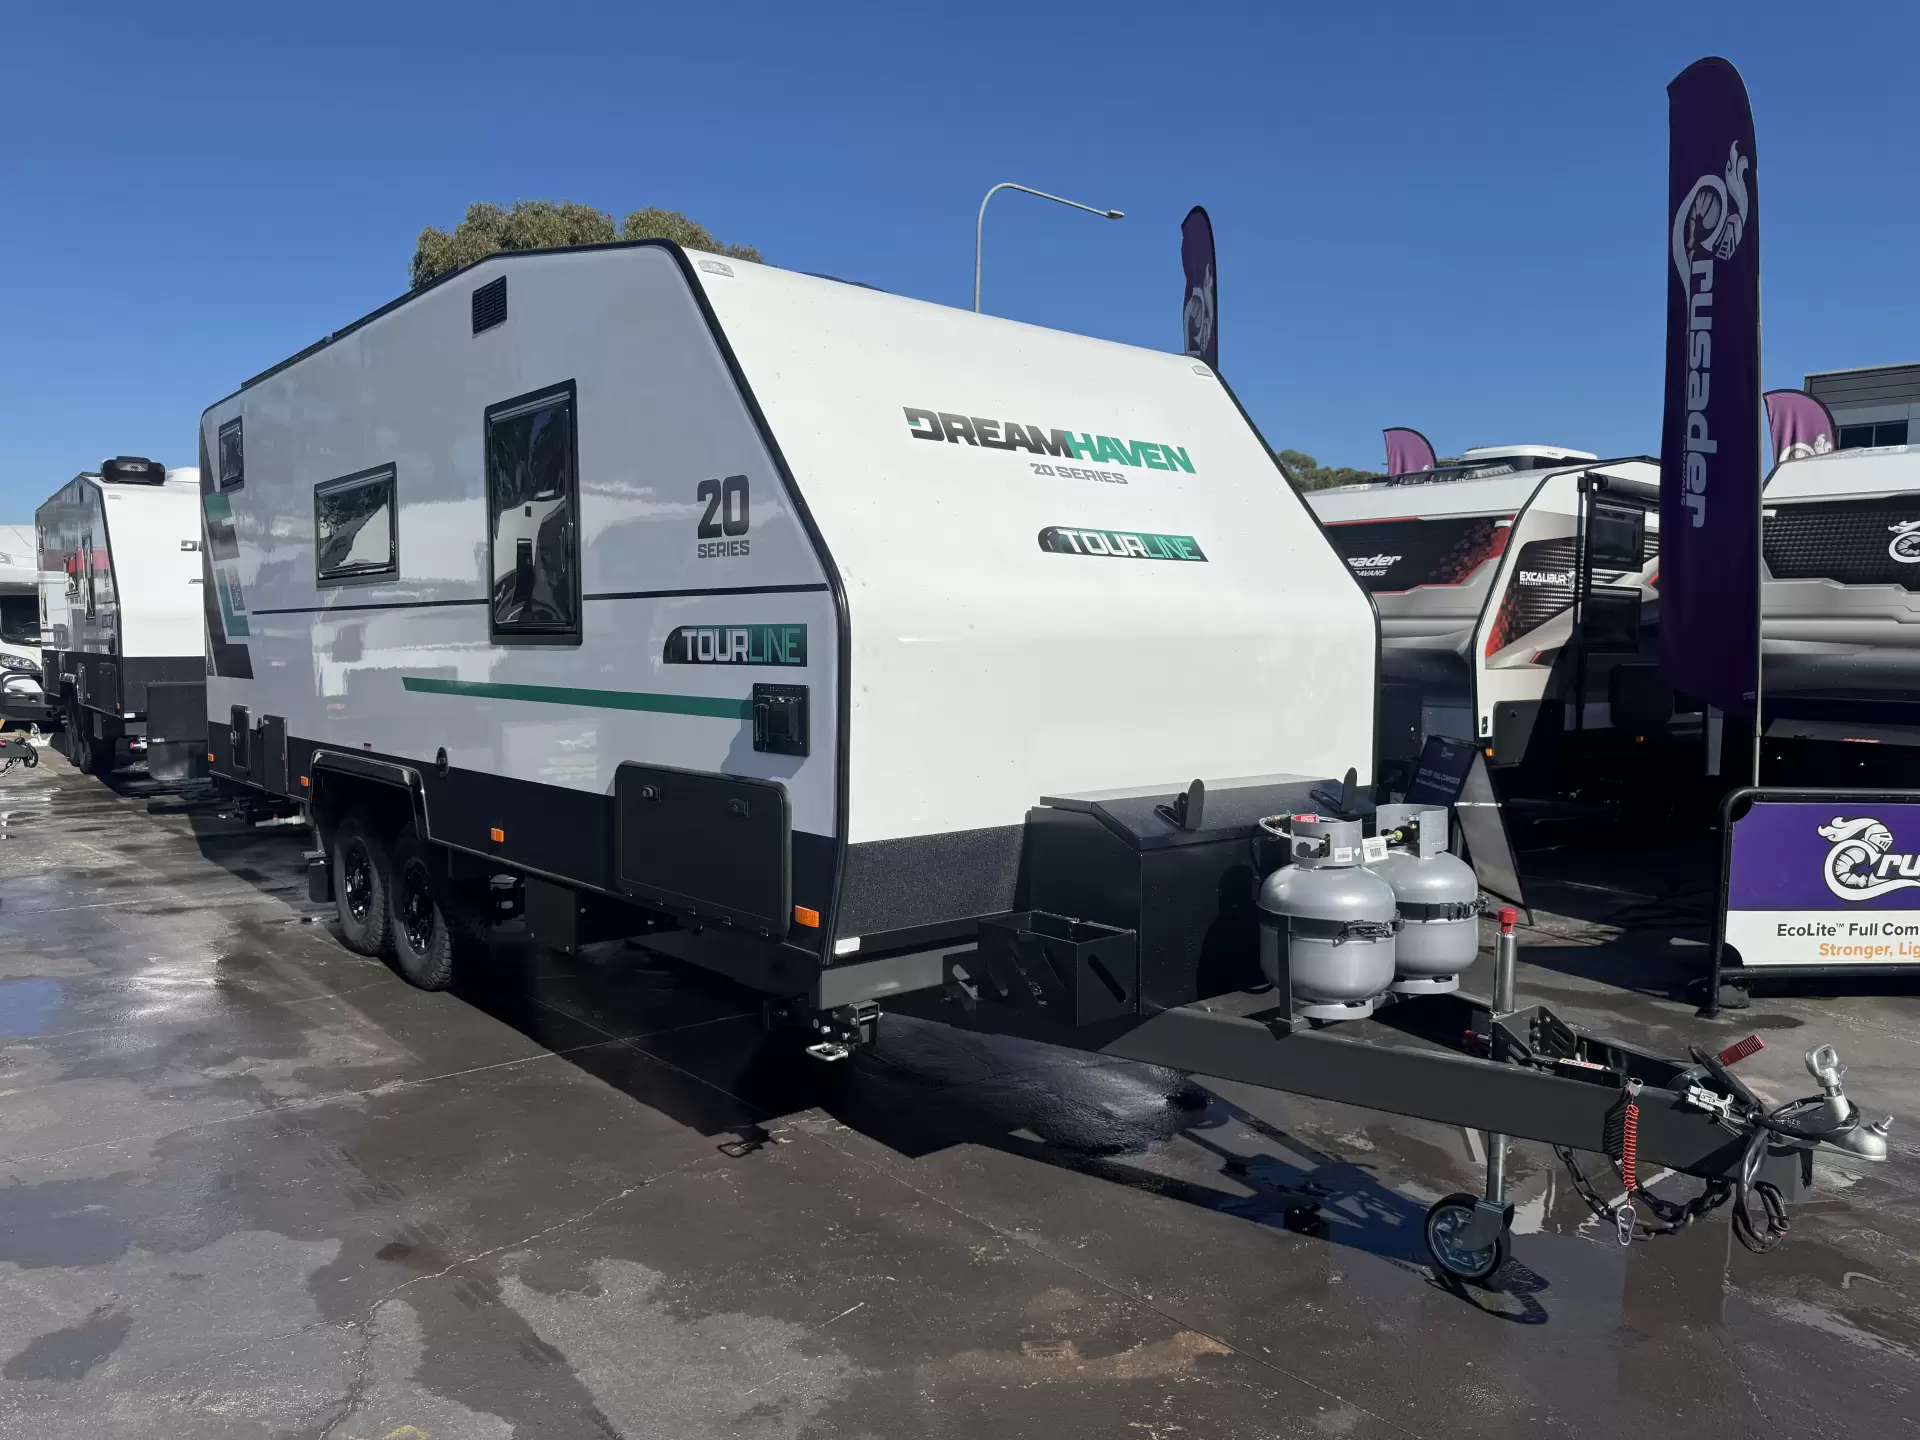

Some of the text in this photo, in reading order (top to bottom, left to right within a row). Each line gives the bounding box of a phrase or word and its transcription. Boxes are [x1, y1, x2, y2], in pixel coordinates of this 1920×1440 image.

[903, 406, 1197, 474] DREAMHAVEN
[1030, 463, 1129, 484] 20 SERIES
[697, 475, 750, 539] 20
[697, 540, 750, 559] SERIES
[1056, 528, 1202, 560] TOURLINE
[1519, 571, 1567, 586] EXCALIBUR
[681, 628, 801, 662] TOURLINE
[1848, 922, 1879, 937] Full
[1882, 922, 1919, 936] Com
[1819, 942, 1894, 959] Stronger,
